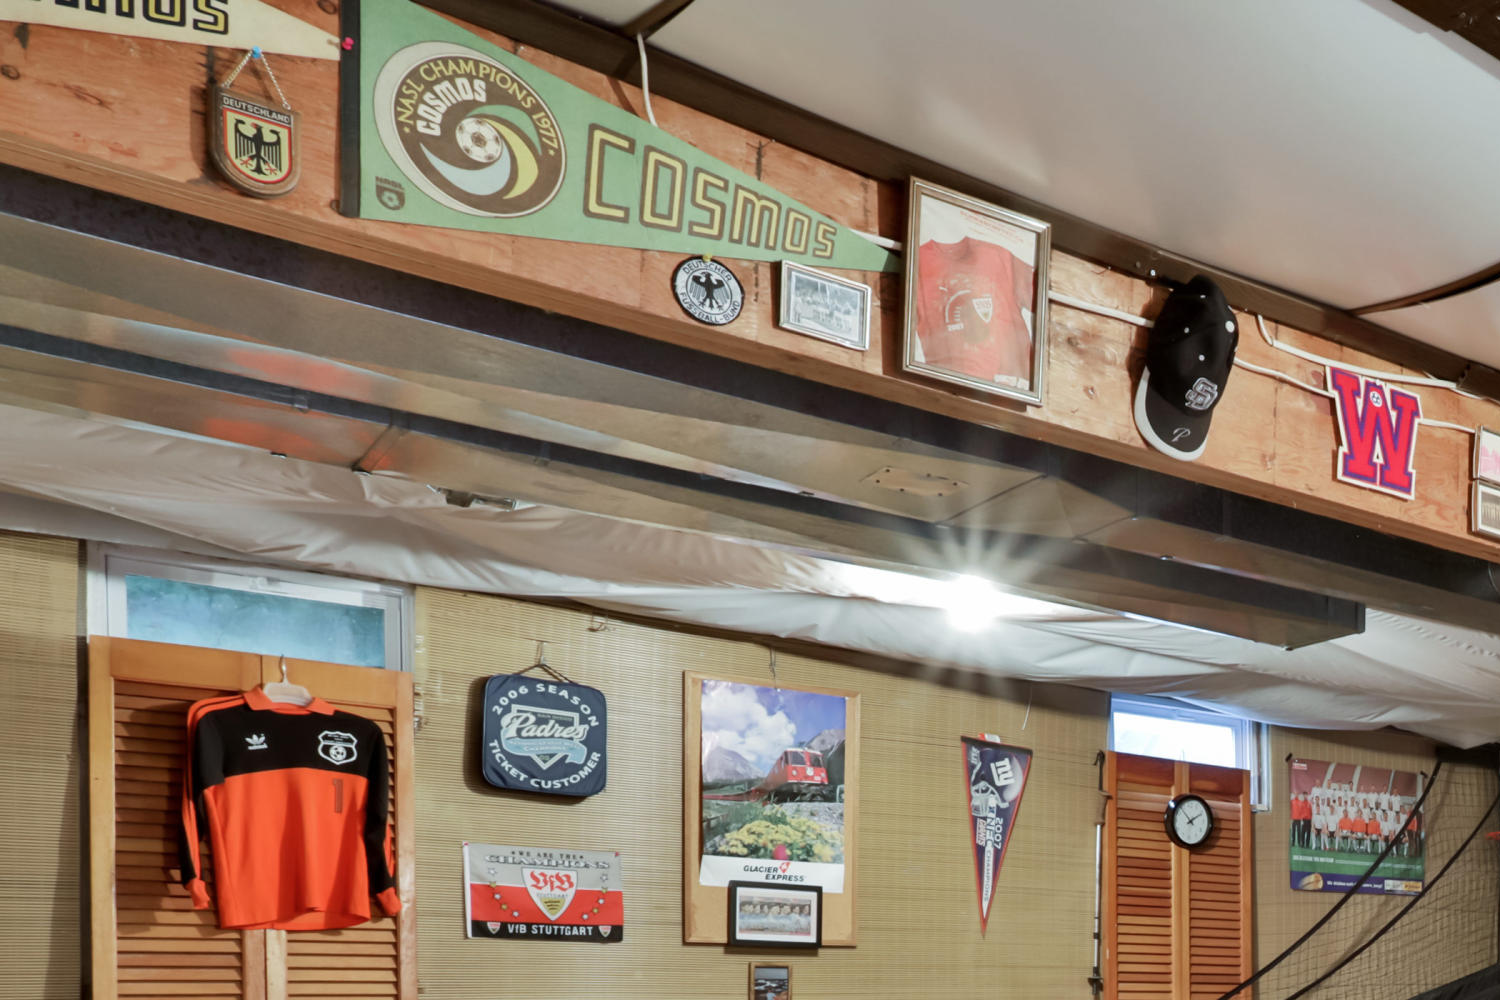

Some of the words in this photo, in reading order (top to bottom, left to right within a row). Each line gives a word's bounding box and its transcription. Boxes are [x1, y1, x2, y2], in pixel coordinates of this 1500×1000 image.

[222, 96, 291, 123] DEUTSCHLAND
[396, 79, 424, 125] NASL
[419, 58, 536, 109] CHAMPIONS
[532, 112, 560, 149] 1977
[416, 77, 487, 136] COSMOS
[582, 123, 838, 259] COSMOS
[682, 260, 732, 281] DEUTSCHER
[680, 291, 740, 323] FUSSBALL-BUND
[1327, 367, 1422, 499] W
[492, 685, 528, 715] 2006
[536, 683, 599, 727] SEASON
[501, 711, 590, 742] Padres
[489, 740, 528, 782] TICKET
[530, 752, 601, 788] CUSTOMER
[994, 817, 1004, 849] 2007
[485, 855, 610, 869] CHAMPIONS
[743, 864, 779, 874] GLACIER
[765, 873, 805, 882] EXPRESS
[529, 870, 575, 892] VfB
[507, 923, 527, 934] VfB
[531, 924, 593, 936] STUTTGART
